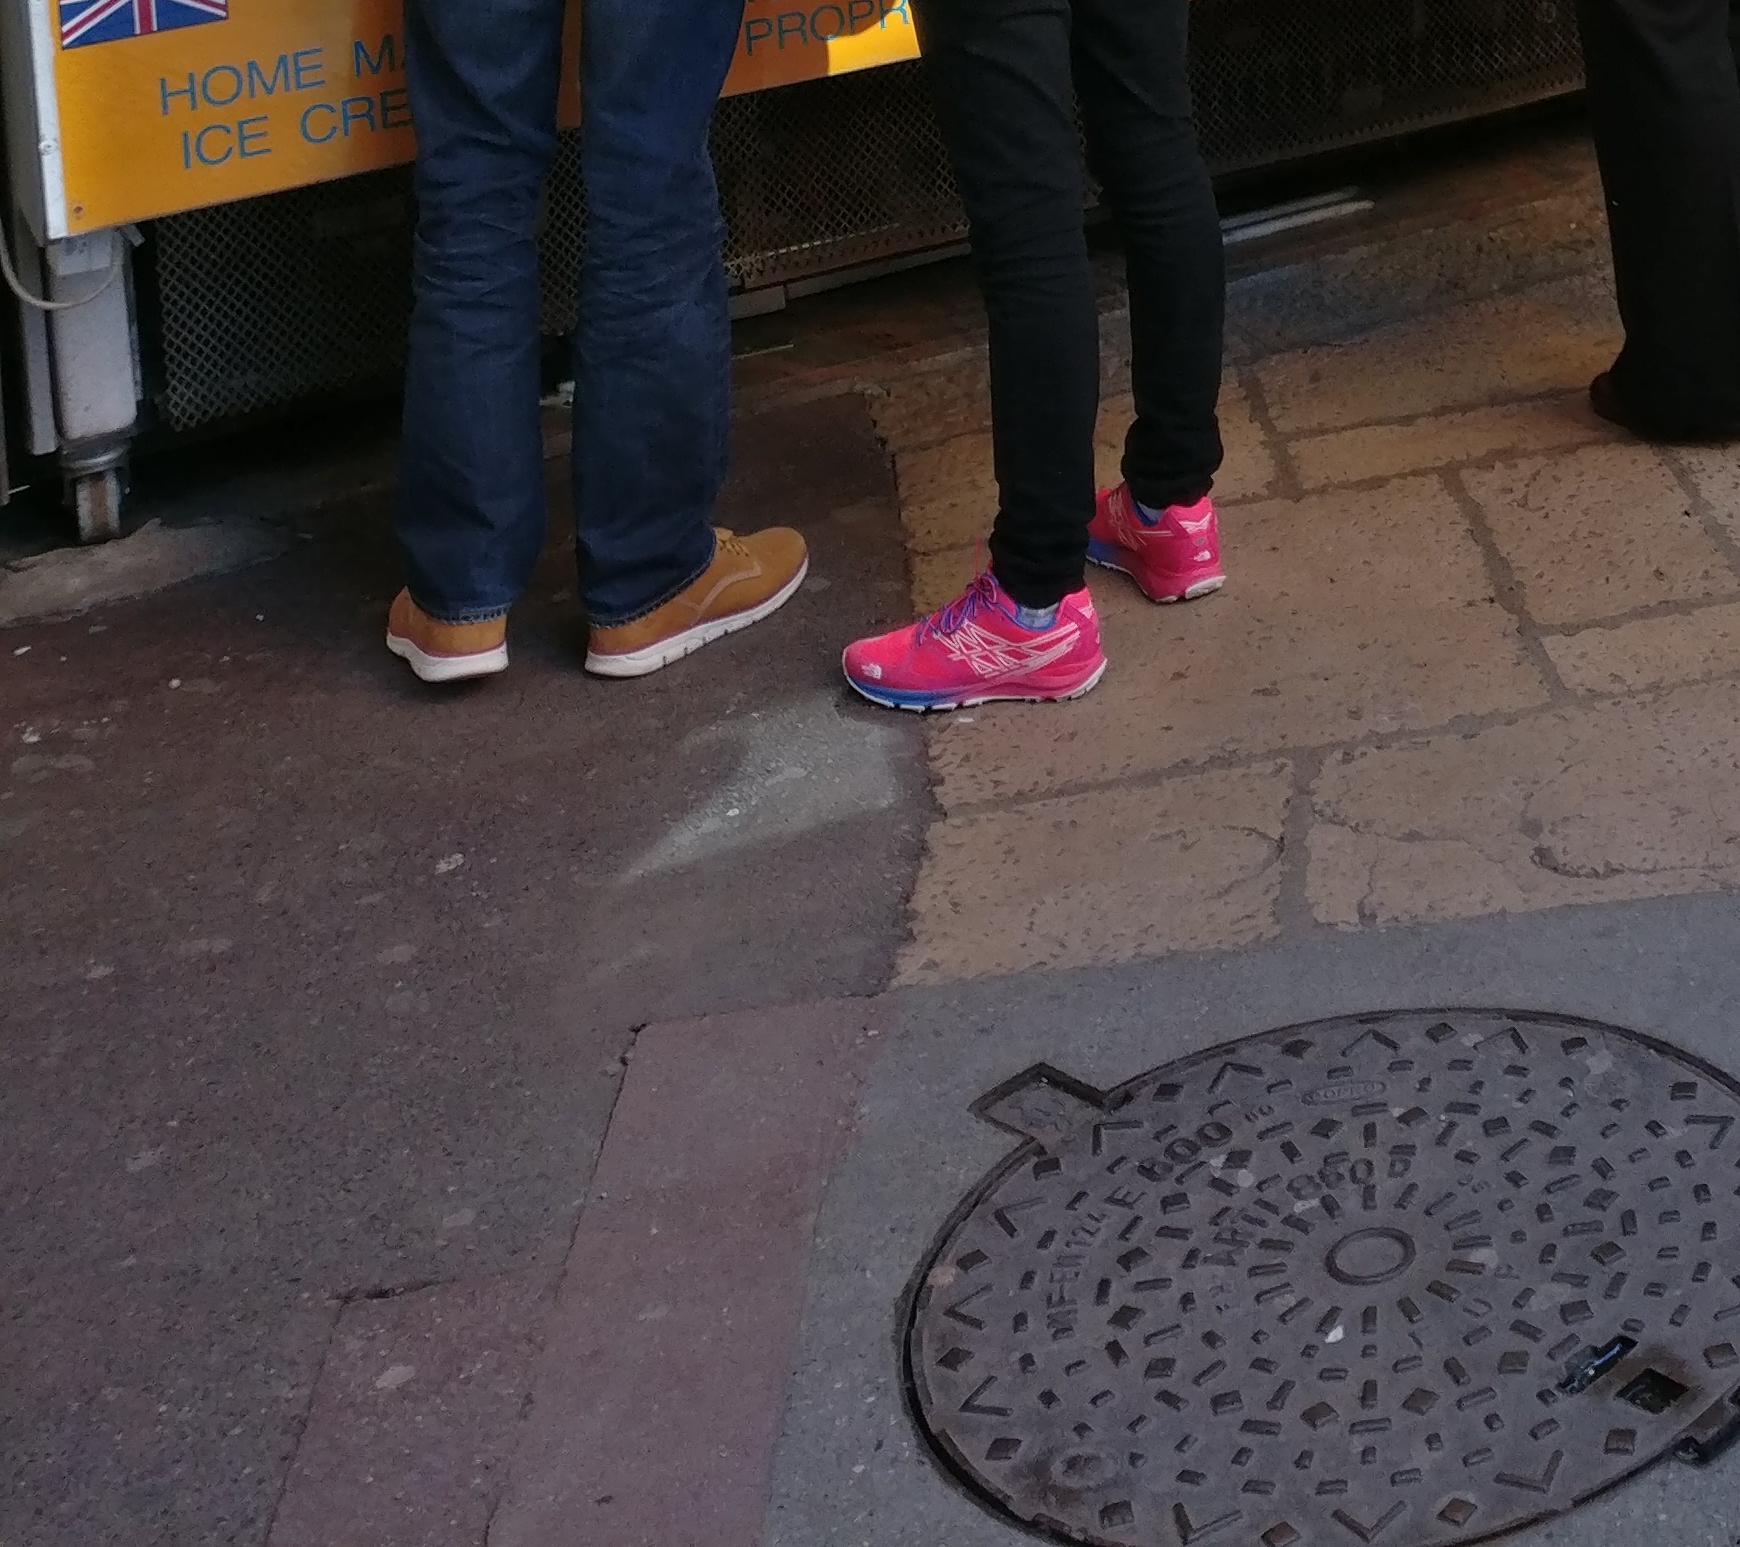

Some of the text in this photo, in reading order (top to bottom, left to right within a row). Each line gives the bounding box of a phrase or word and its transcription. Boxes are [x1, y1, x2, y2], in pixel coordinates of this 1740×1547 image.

[160, 47, 327, 116] HOME
[181, 87, 415, 170] ICE CRE
